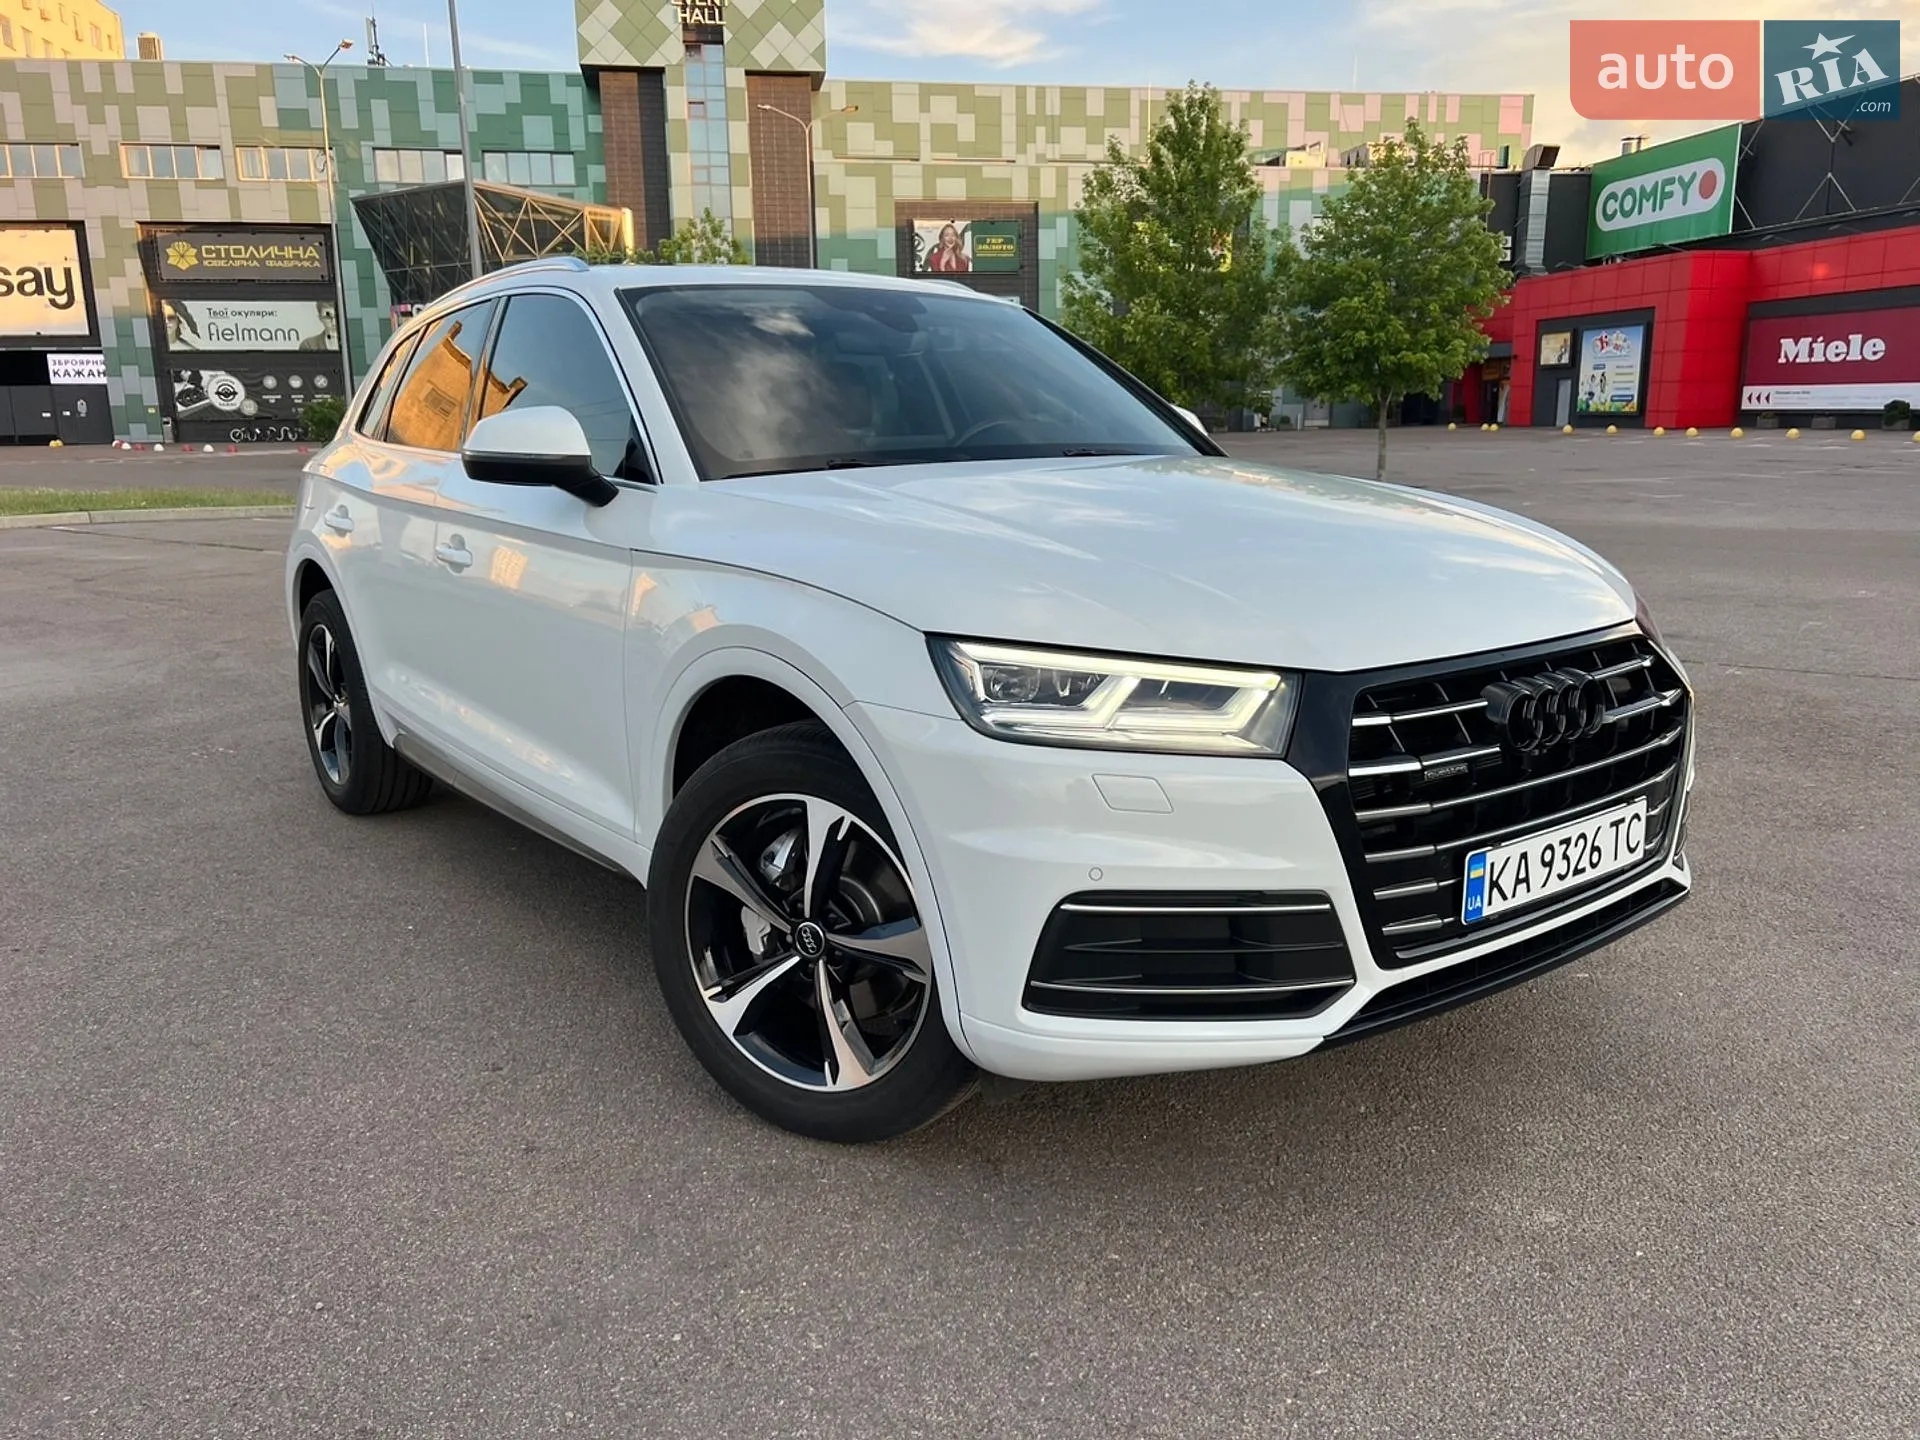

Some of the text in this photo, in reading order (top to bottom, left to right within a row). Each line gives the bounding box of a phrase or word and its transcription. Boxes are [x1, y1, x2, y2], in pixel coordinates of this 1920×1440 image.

[677, 7, 726, 24] HALL
[1601, 170, 1697, 223] COMFY
[201, 245, 320, 259] СТОЛИЧНА
[265, 259, 321, 268] ФАБРИКА
[206, 307, 278, 319] Твої окуляри:
[207, 322, 300, 342] fielmann
[1777, 333, 1886, 364] Miele
[52, 368, 106, 378] КАЖАН
[1487, 812, 1642, 907] KA 9326 TC
[1467, 894, 1482, 910] UA
